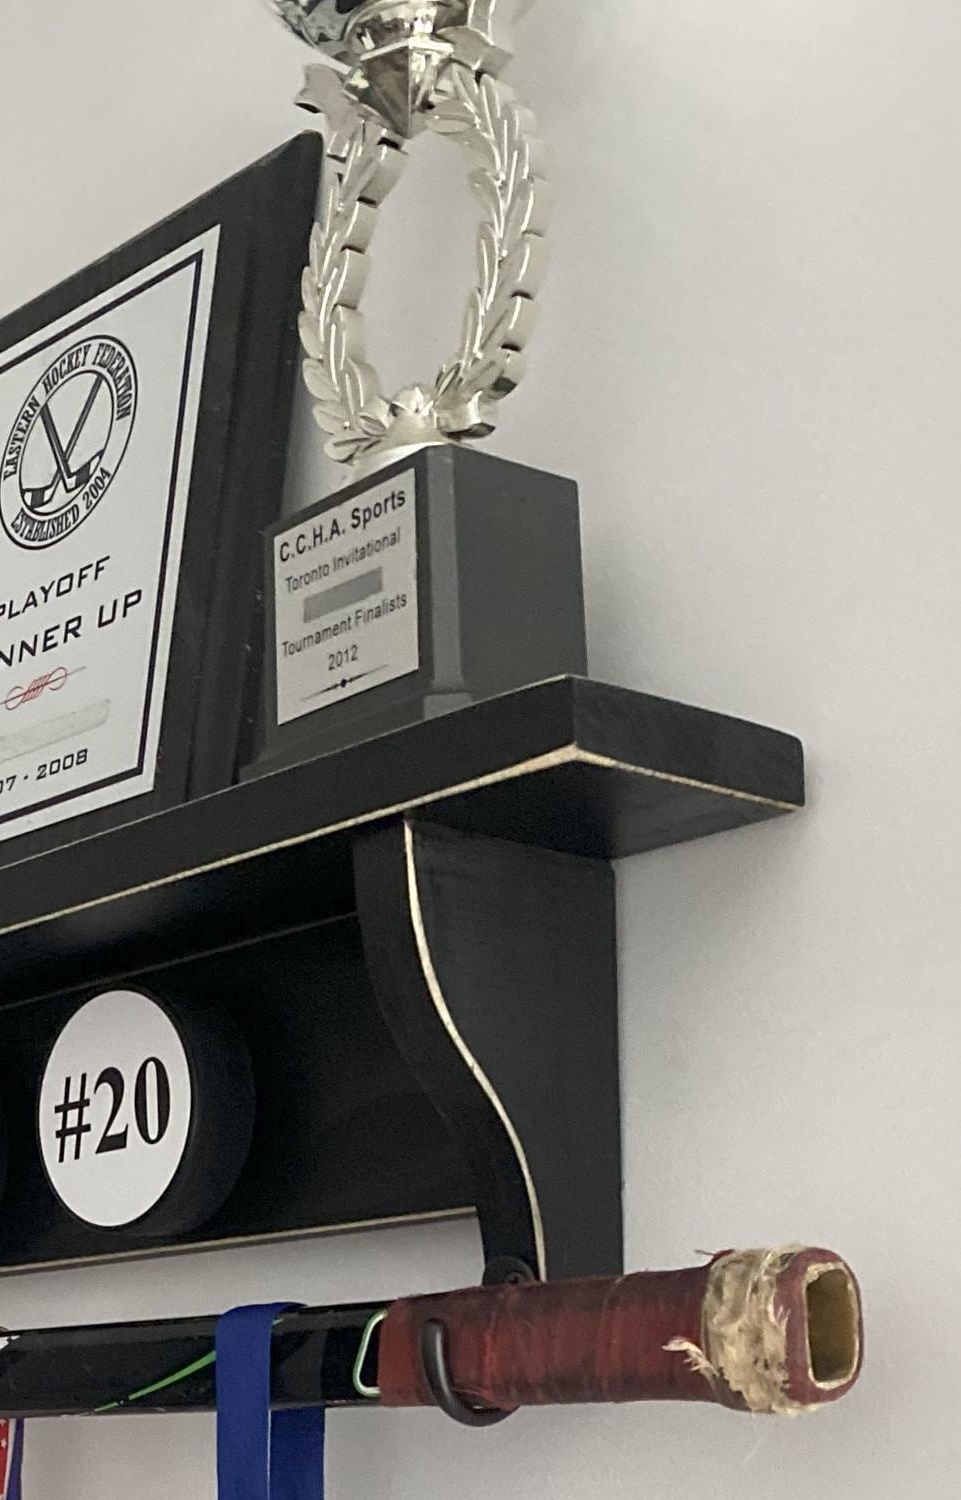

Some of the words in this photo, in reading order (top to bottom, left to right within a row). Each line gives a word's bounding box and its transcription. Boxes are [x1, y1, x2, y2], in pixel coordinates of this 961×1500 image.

[4, 395, 41, 480] EASTERN
[41, 343, 92, 395] HOCKEY
[91, 342, 133, 421] FEDERATION
[11, 504, 80, 542] ESTABLISHED
[82, 467, 112, 510] 2004
[279, 518, 345, 562] C.C.H.A.
[351, 490, 406, 530] Sports
[285, 563, 330, 593] Toronto
[333, 526, 401, 572] Invitational
[97, 589, 143, 629] UP
[282, 616, 352, 658] Tournament
[355, 594, 408, 627] Finalists
[328, 644, 359, 672] 2012
[36, 748, 88, 781] 2008
[54, 1056, 171, 1164] #20
